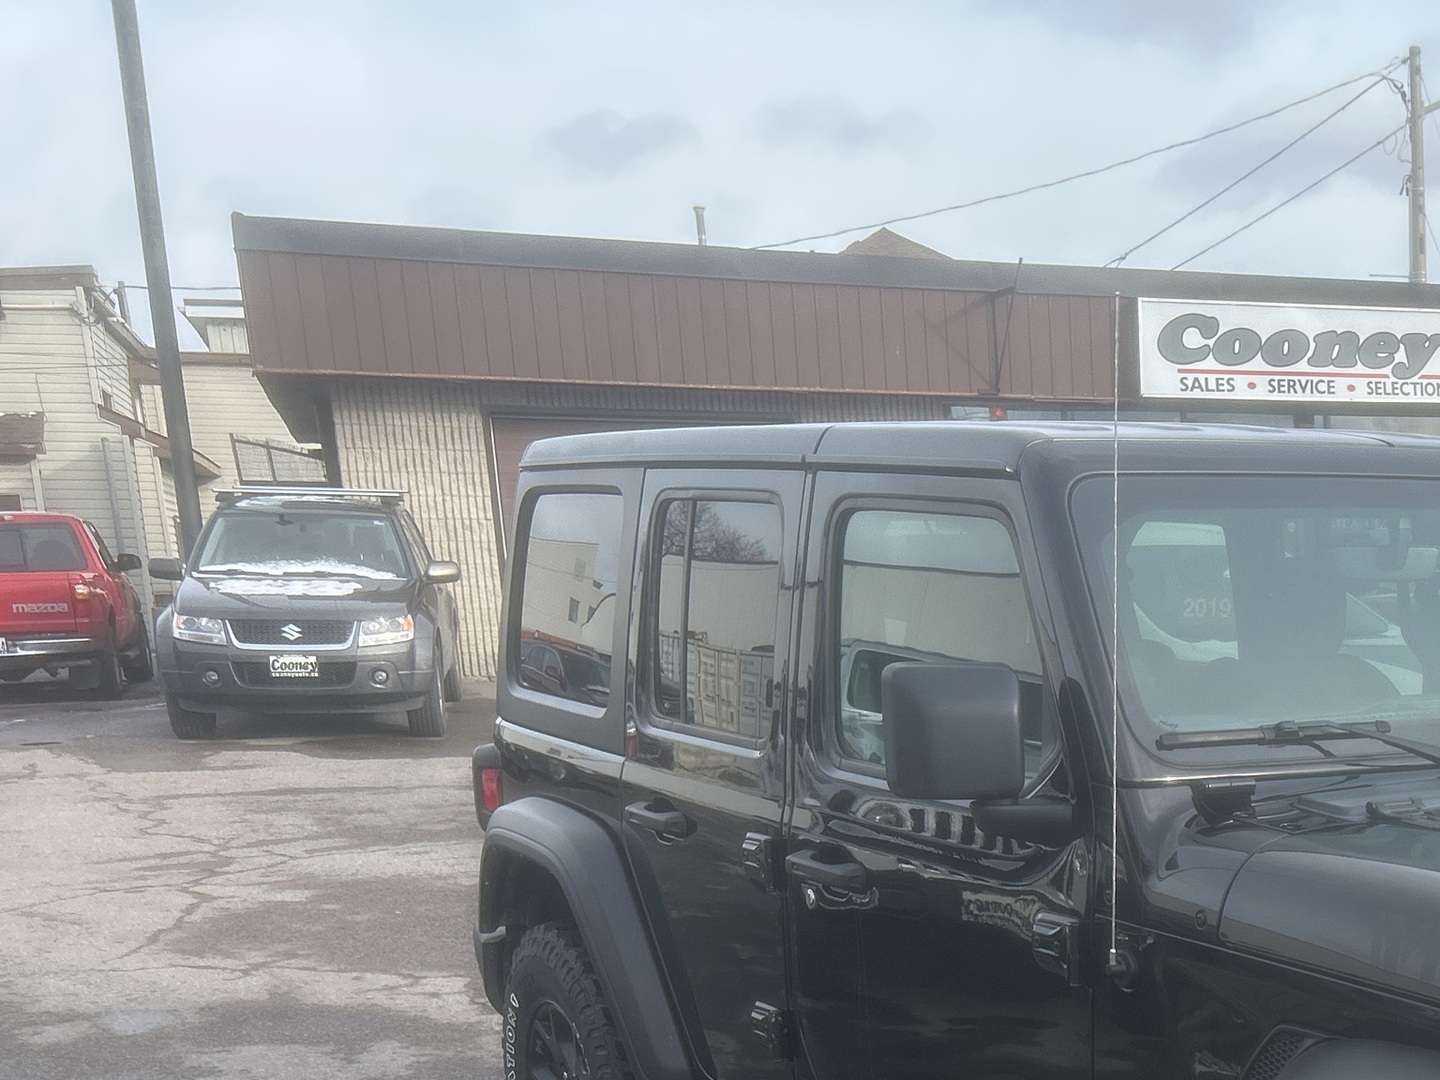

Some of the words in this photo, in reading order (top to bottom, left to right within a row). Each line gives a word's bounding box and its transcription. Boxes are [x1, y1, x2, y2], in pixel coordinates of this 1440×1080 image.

[1179, 376, 1236, 393] SALES
[1267, 378, 1336, 395] SERVICE
[12, 603, 69, 613] mazda
[1183, 598, 1232, 618] 2019
[271, 659, 319, 673] Cooney
